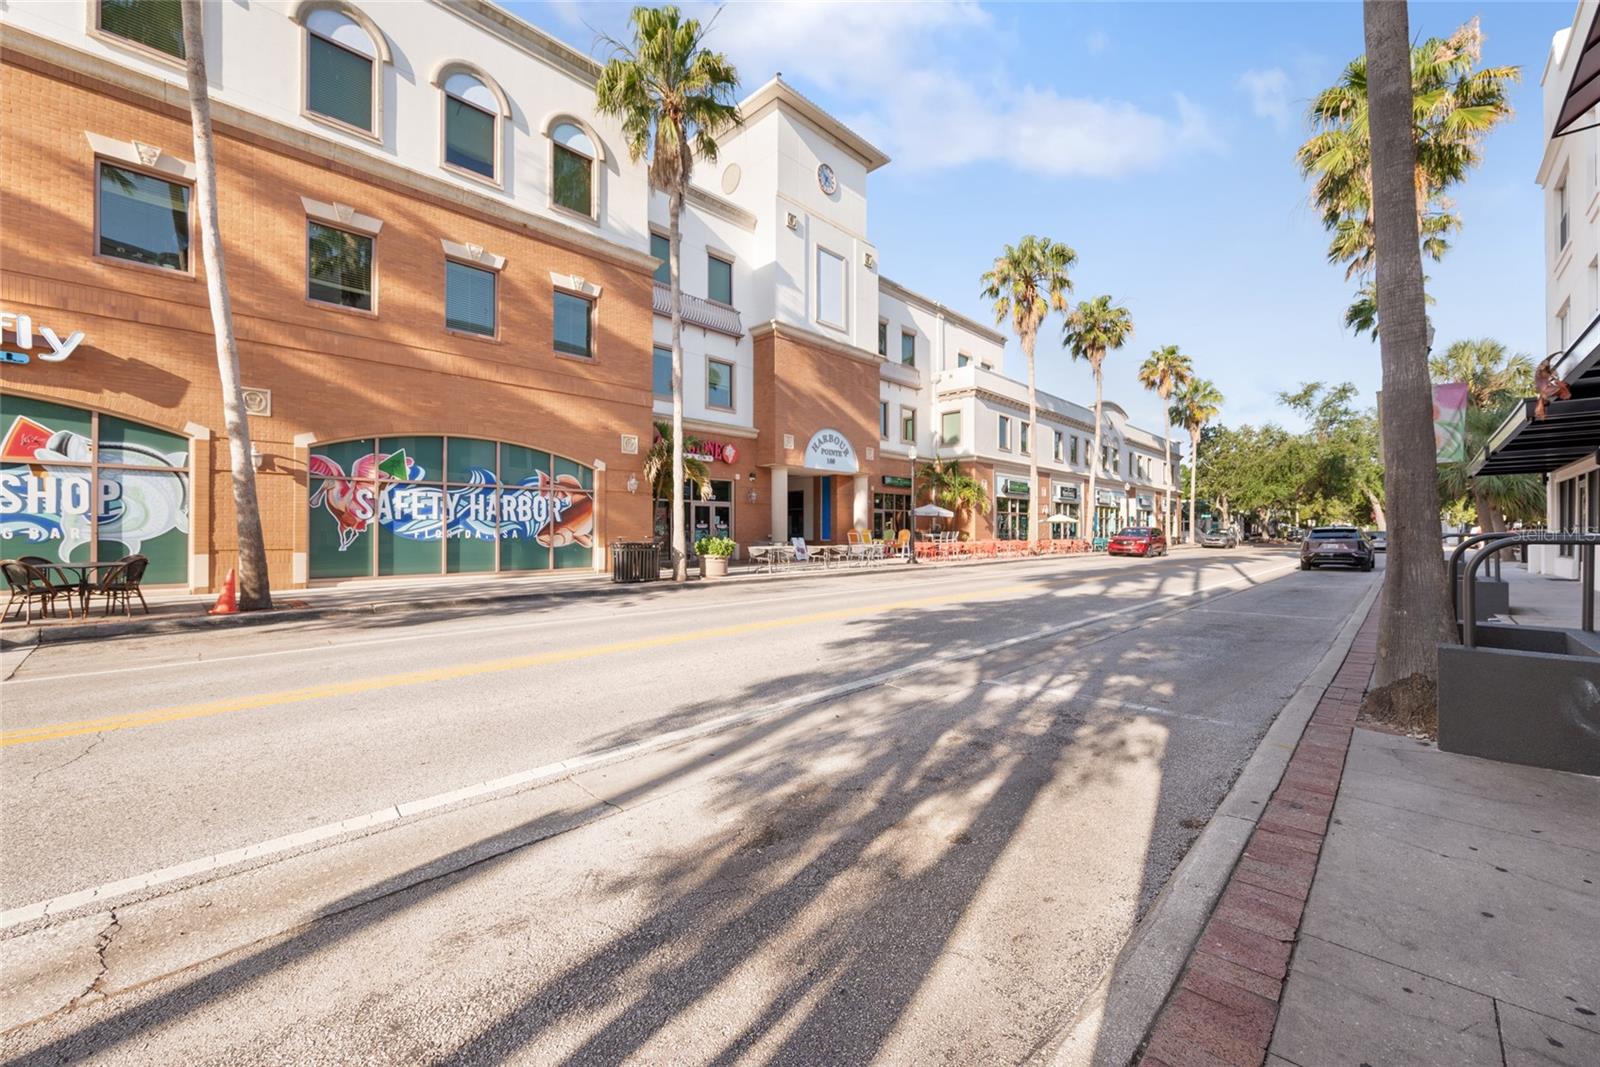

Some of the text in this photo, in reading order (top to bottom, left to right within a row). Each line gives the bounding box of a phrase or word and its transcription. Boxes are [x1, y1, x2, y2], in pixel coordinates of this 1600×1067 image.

[811, 433, 850, 457] HARBOUR
[820, 447, 843, 457] POINTE
[0, 473, 121, 515] SHOP
[355, 488, 561, 522] SAFETY HARBOR
